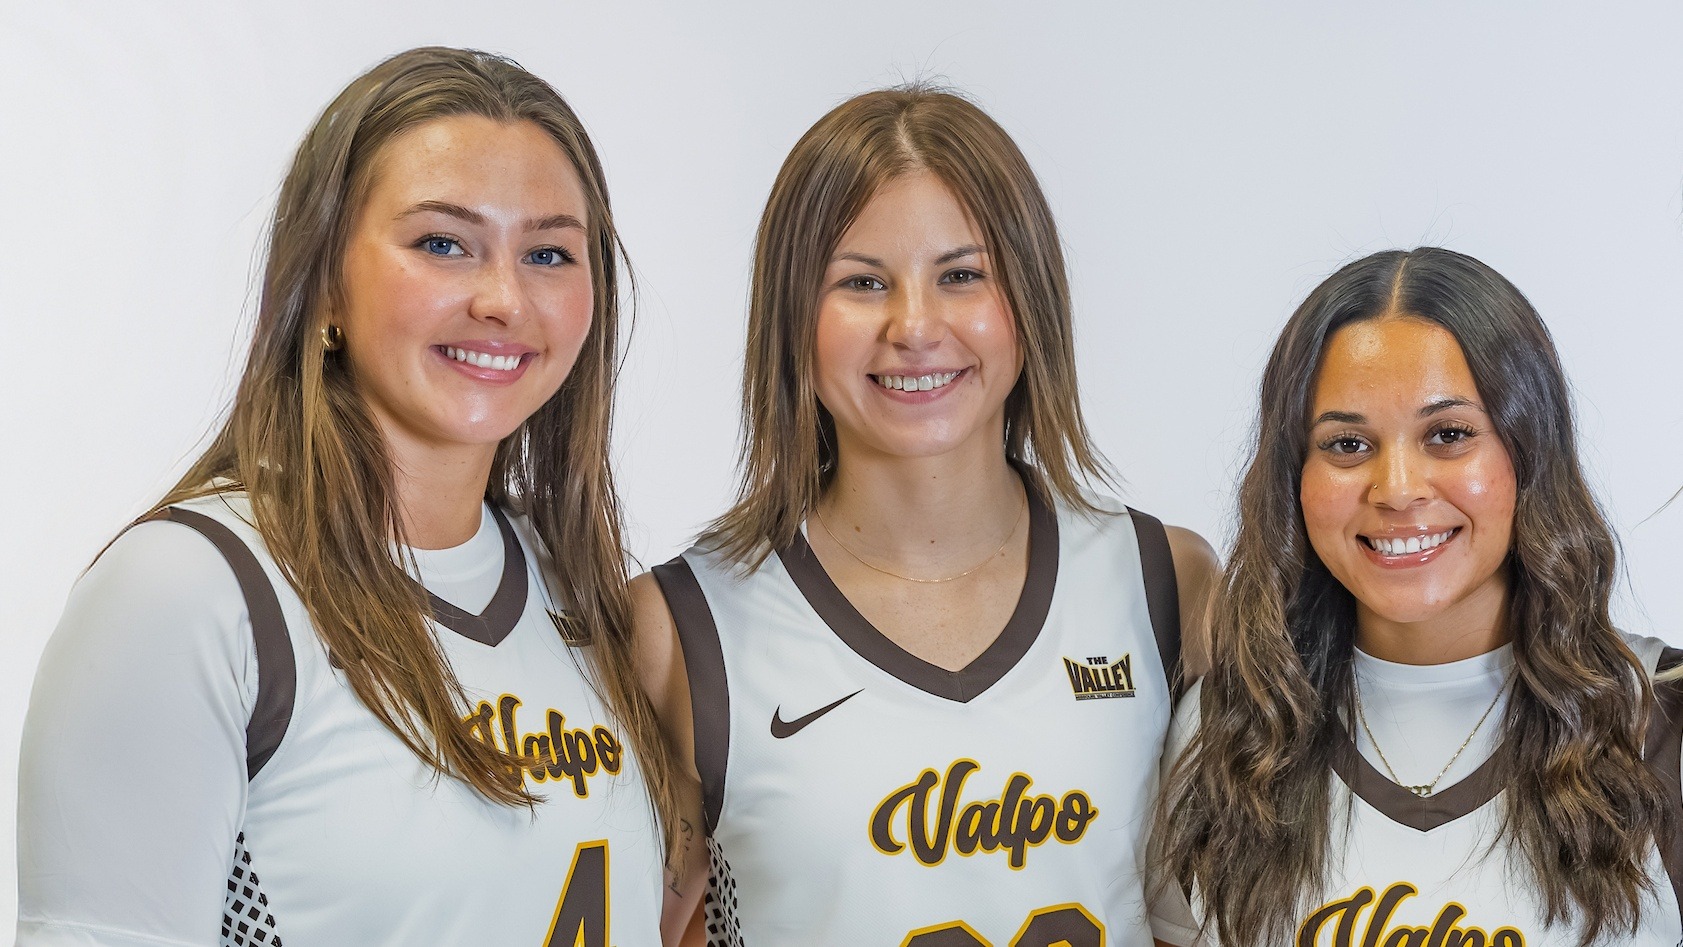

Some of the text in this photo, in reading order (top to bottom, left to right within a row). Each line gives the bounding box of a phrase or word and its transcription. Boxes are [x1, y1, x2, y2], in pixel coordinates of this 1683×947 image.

[1063, 653, 1134, 693] VALLEY
[1086, 656, 1108, 665] THE
[868, 757, 1099, 871] Valpo
